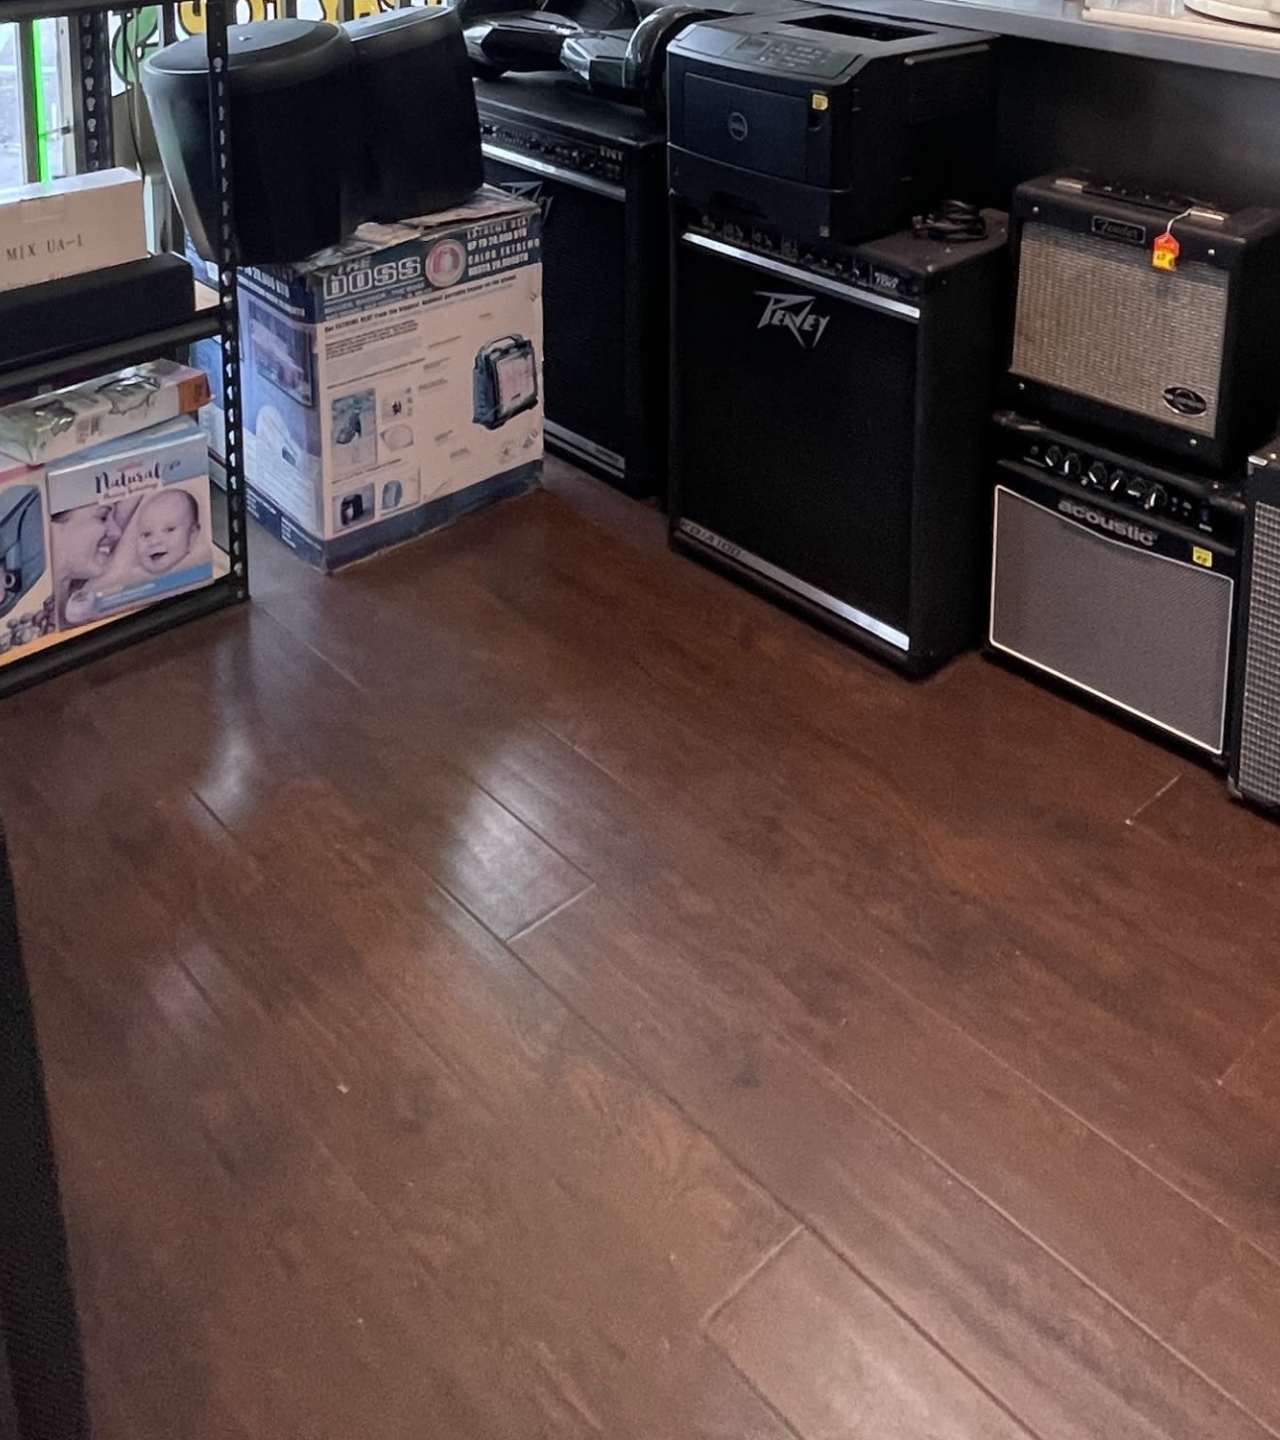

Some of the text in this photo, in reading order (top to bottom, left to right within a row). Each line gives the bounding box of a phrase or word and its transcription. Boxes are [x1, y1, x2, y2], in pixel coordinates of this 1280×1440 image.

[6, 233, 84, 262] MIX UA-1
[1058, 499, 1154, 547] acoustic
